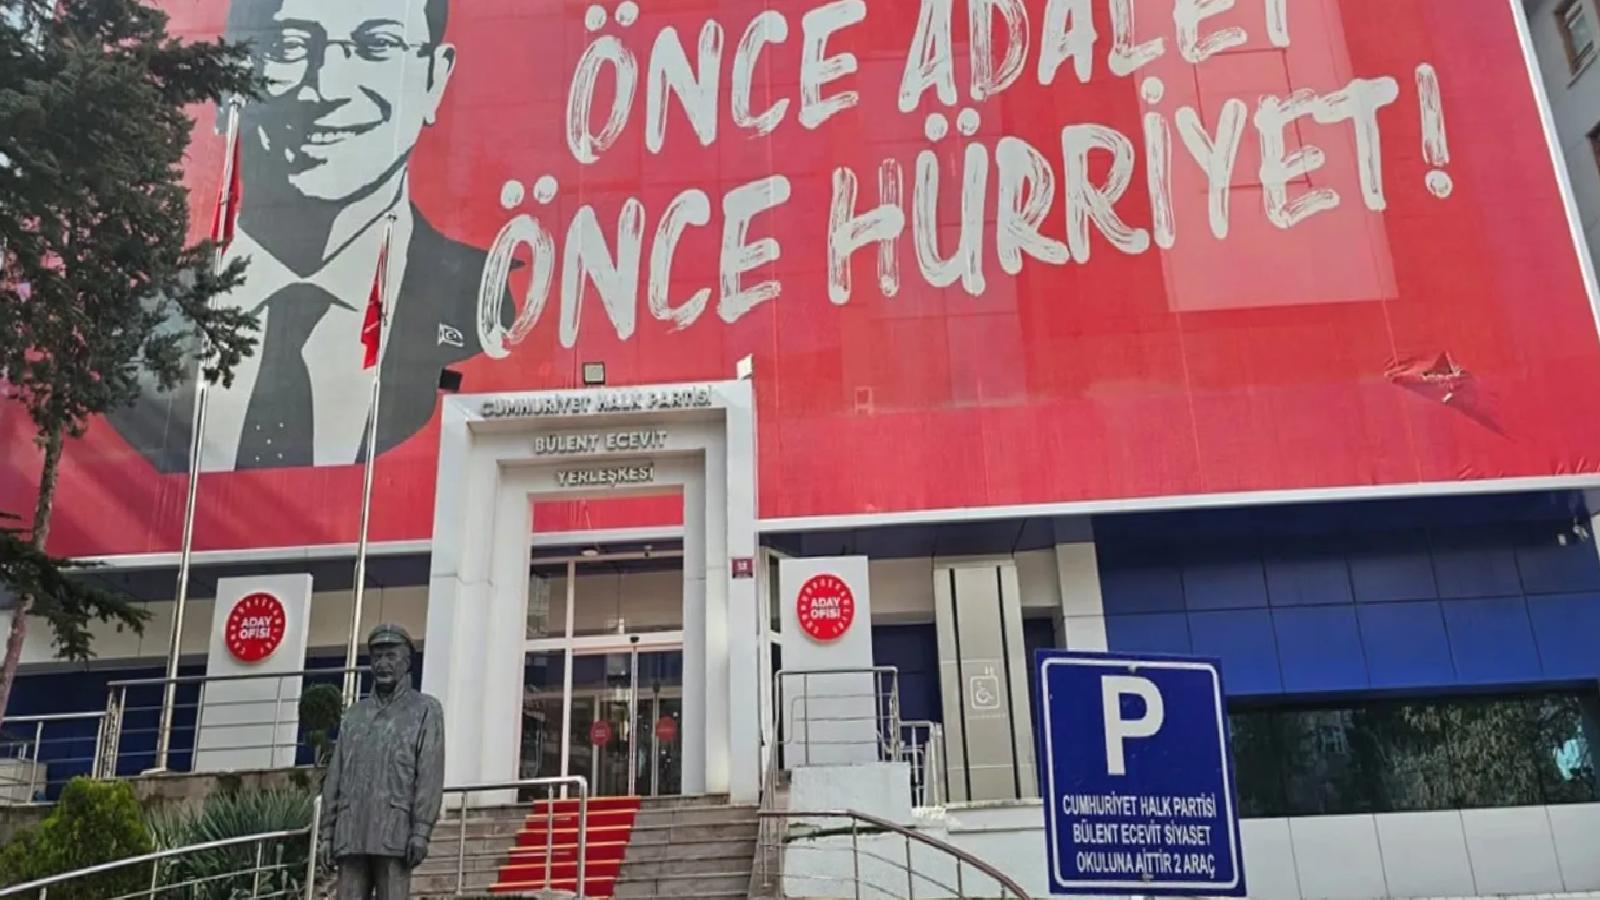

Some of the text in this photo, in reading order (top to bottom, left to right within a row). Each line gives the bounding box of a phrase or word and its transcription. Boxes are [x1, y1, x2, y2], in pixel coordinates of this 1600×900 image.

[566, 0, 867, 164] ÖNCE
[476, 174, 791, 359] ÖNCE
[482, 386, 712, 417] CUMHURİYET HALK PARTİSİ
[533, 429, 667, 455] BÜLENT ECEVİT
[556, 461, 656, 488] YERLEŞKESİ
[810, 597, 841, 607] ADAY
[241, 615, 272, 627] ADAY
[1101, 675, 1164, 776] P
[1062, 790, 1217, 818] CUMHURİYET HALK PARTİSİ
[1073, 819, 1211, 845] BÜLENT ECEVİT SİYASET
[1076, 848, 1215, 878] OKULUNA AİTTİR 2 ARAÇ
